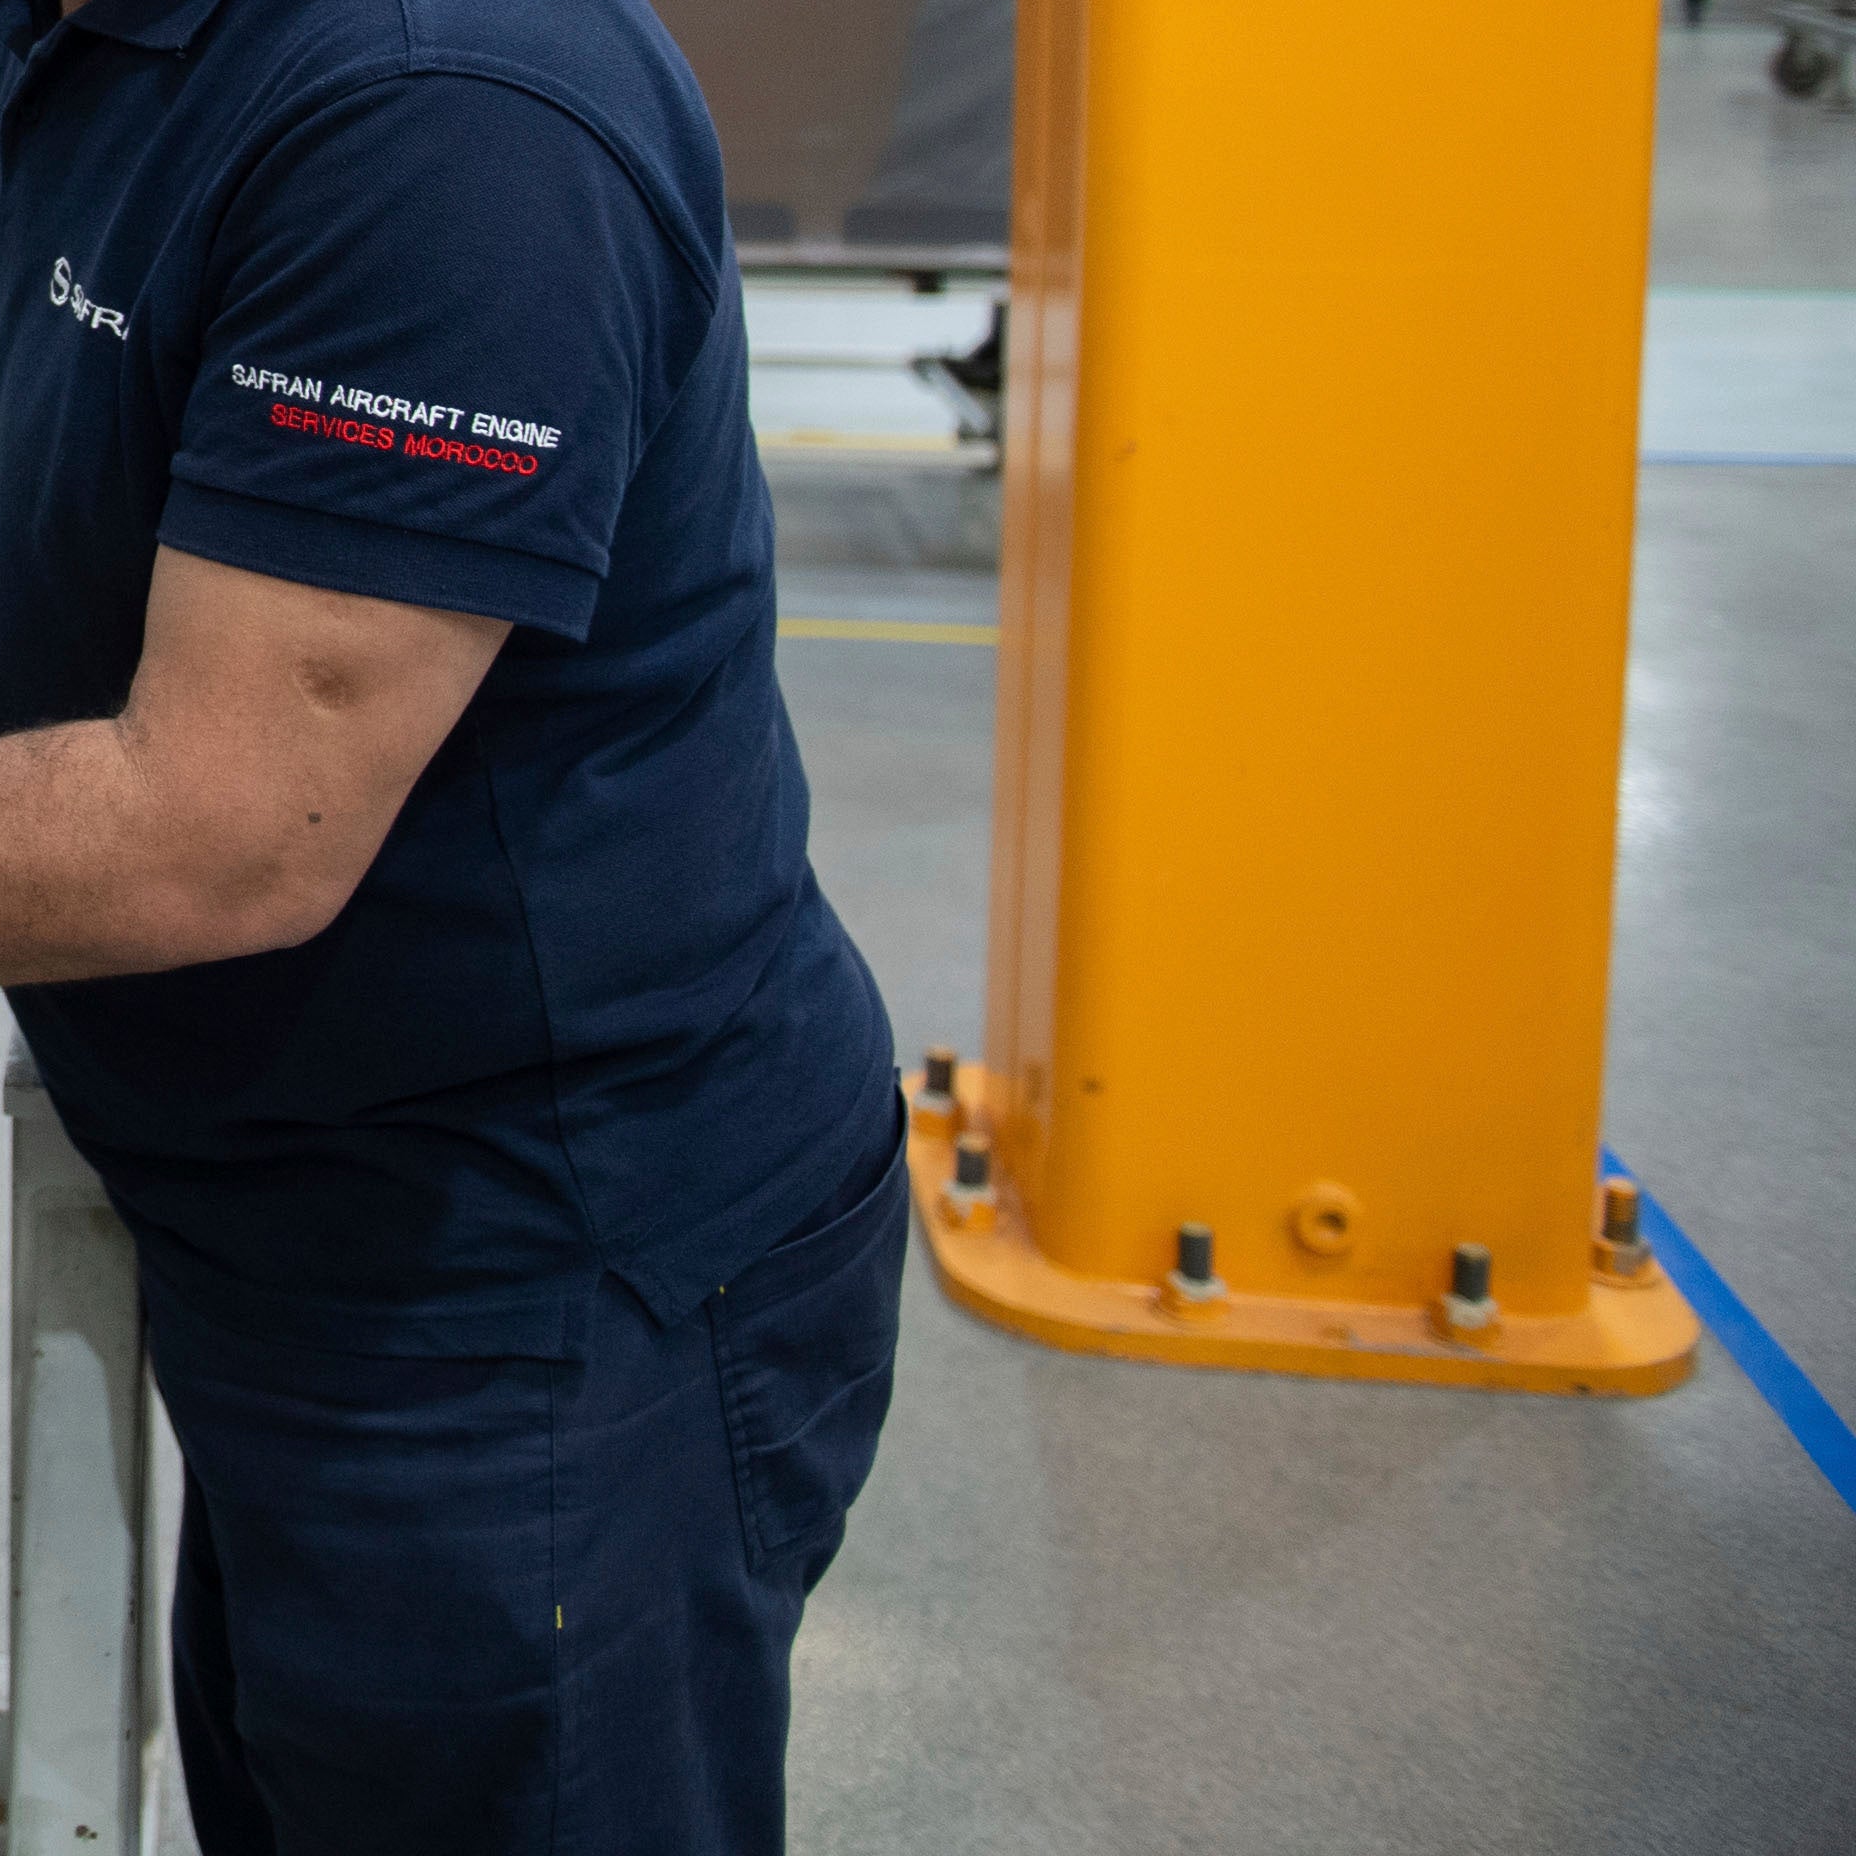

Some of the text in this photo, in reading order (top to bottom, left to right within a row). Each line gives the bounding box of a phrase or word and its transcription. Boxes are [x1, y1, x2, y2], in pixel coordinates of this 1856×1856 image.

[231, 363, 563, 448] SAFRAN AIRCRAFT ENGINE
[271, 403, 539, 476] SERVICES MOROCCO
